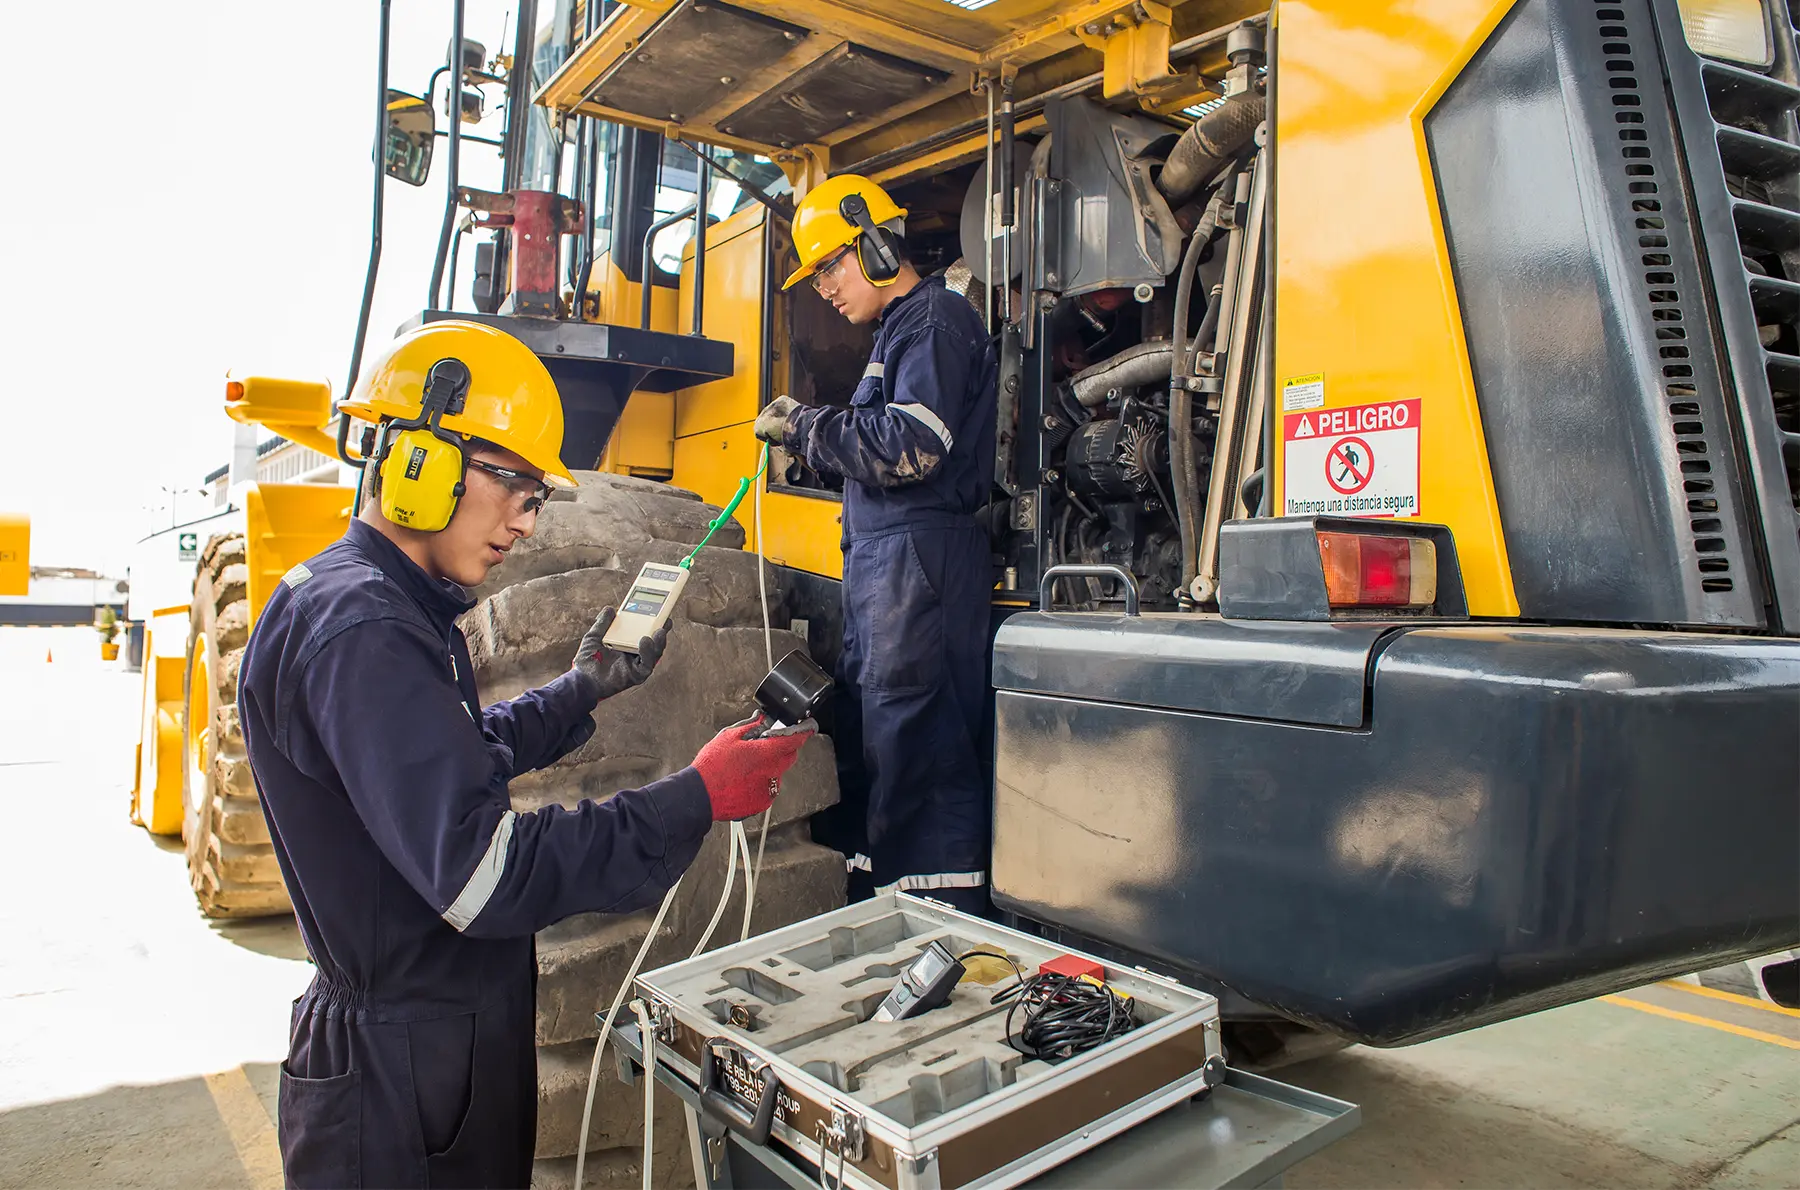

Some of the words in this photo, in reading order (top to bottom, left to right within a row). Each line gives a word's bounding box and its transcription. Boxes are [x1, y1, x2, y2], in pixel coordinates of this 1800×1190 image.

[1319, 403, 1409, 435] PELIGRO
[1288, 498, 1325, 515] Mantenga
[1327, 500, 1342, 512] una
[1344, 494, 1382, 512] distancia
[1384, 494, 1415, 513] segura
[776, 1091, 801, 1115] ROUP
